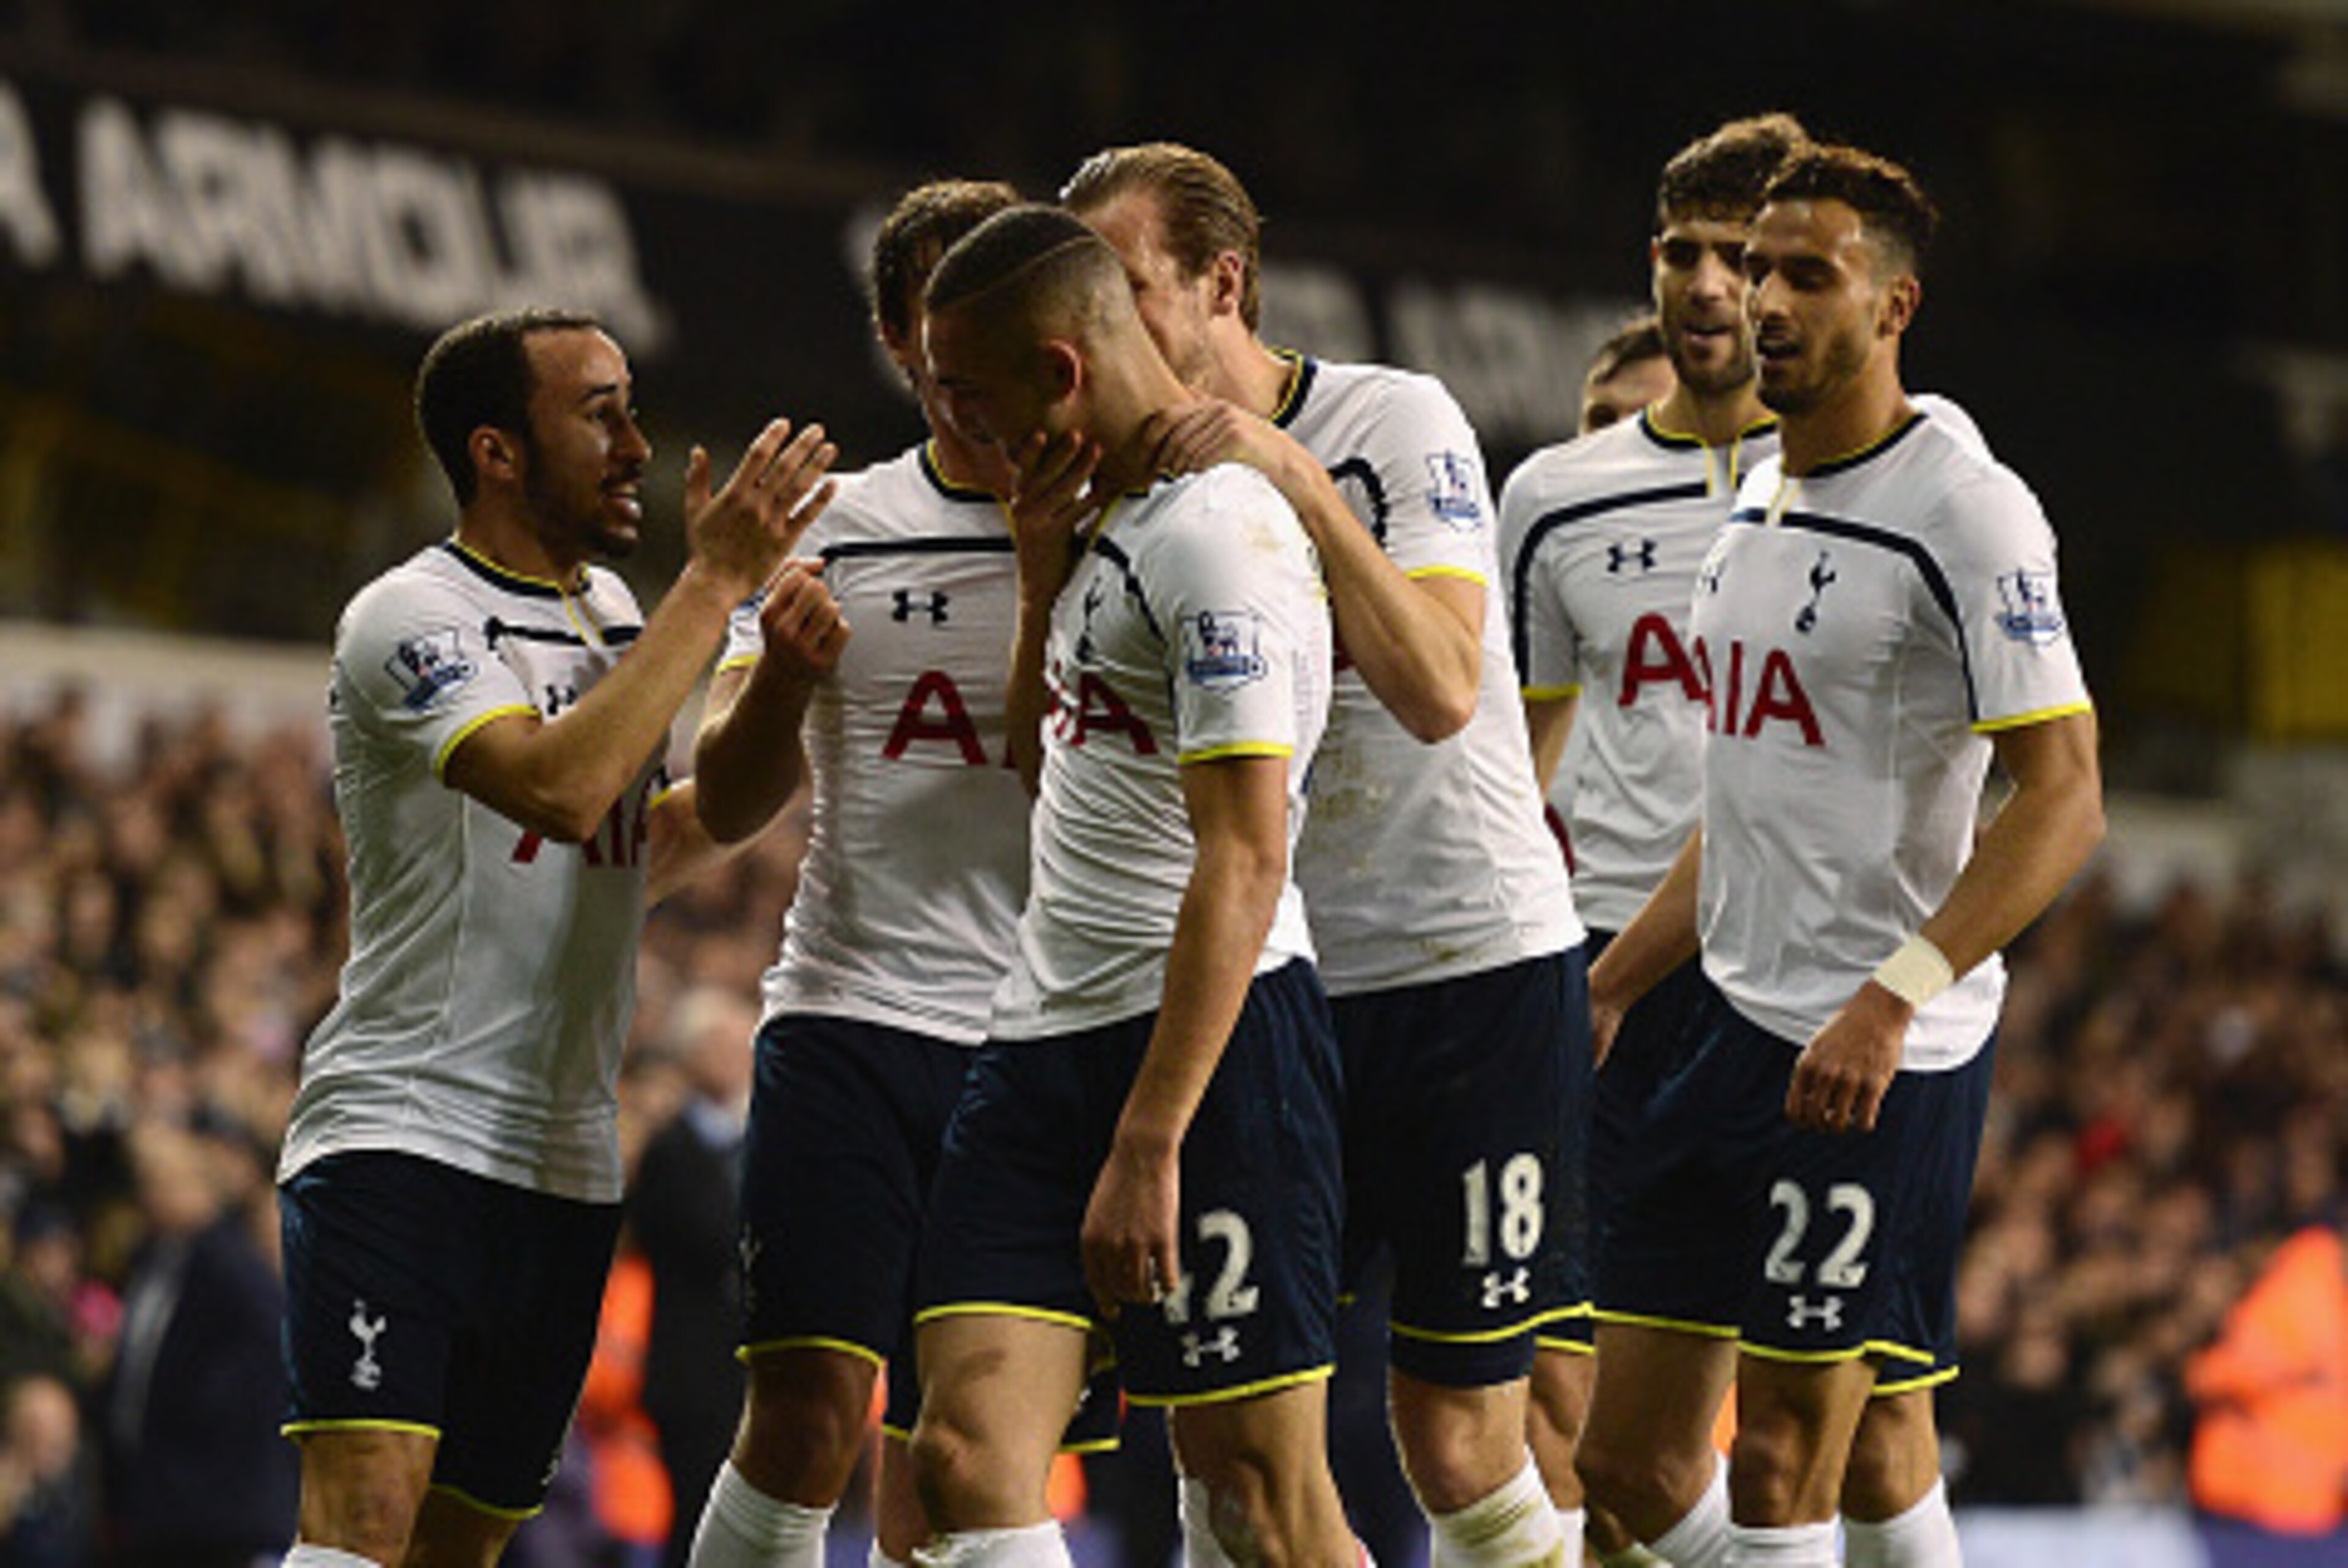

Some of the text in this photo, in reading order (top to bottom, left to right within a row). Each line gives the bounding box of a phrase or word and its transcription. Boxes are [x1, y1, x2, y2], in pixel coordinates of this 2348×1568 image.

[78, 93, 663, 355] ARMOUR
[1463, 1153, 1544, 1265] 18
[1765, 1180, 1874, 1287] 22
